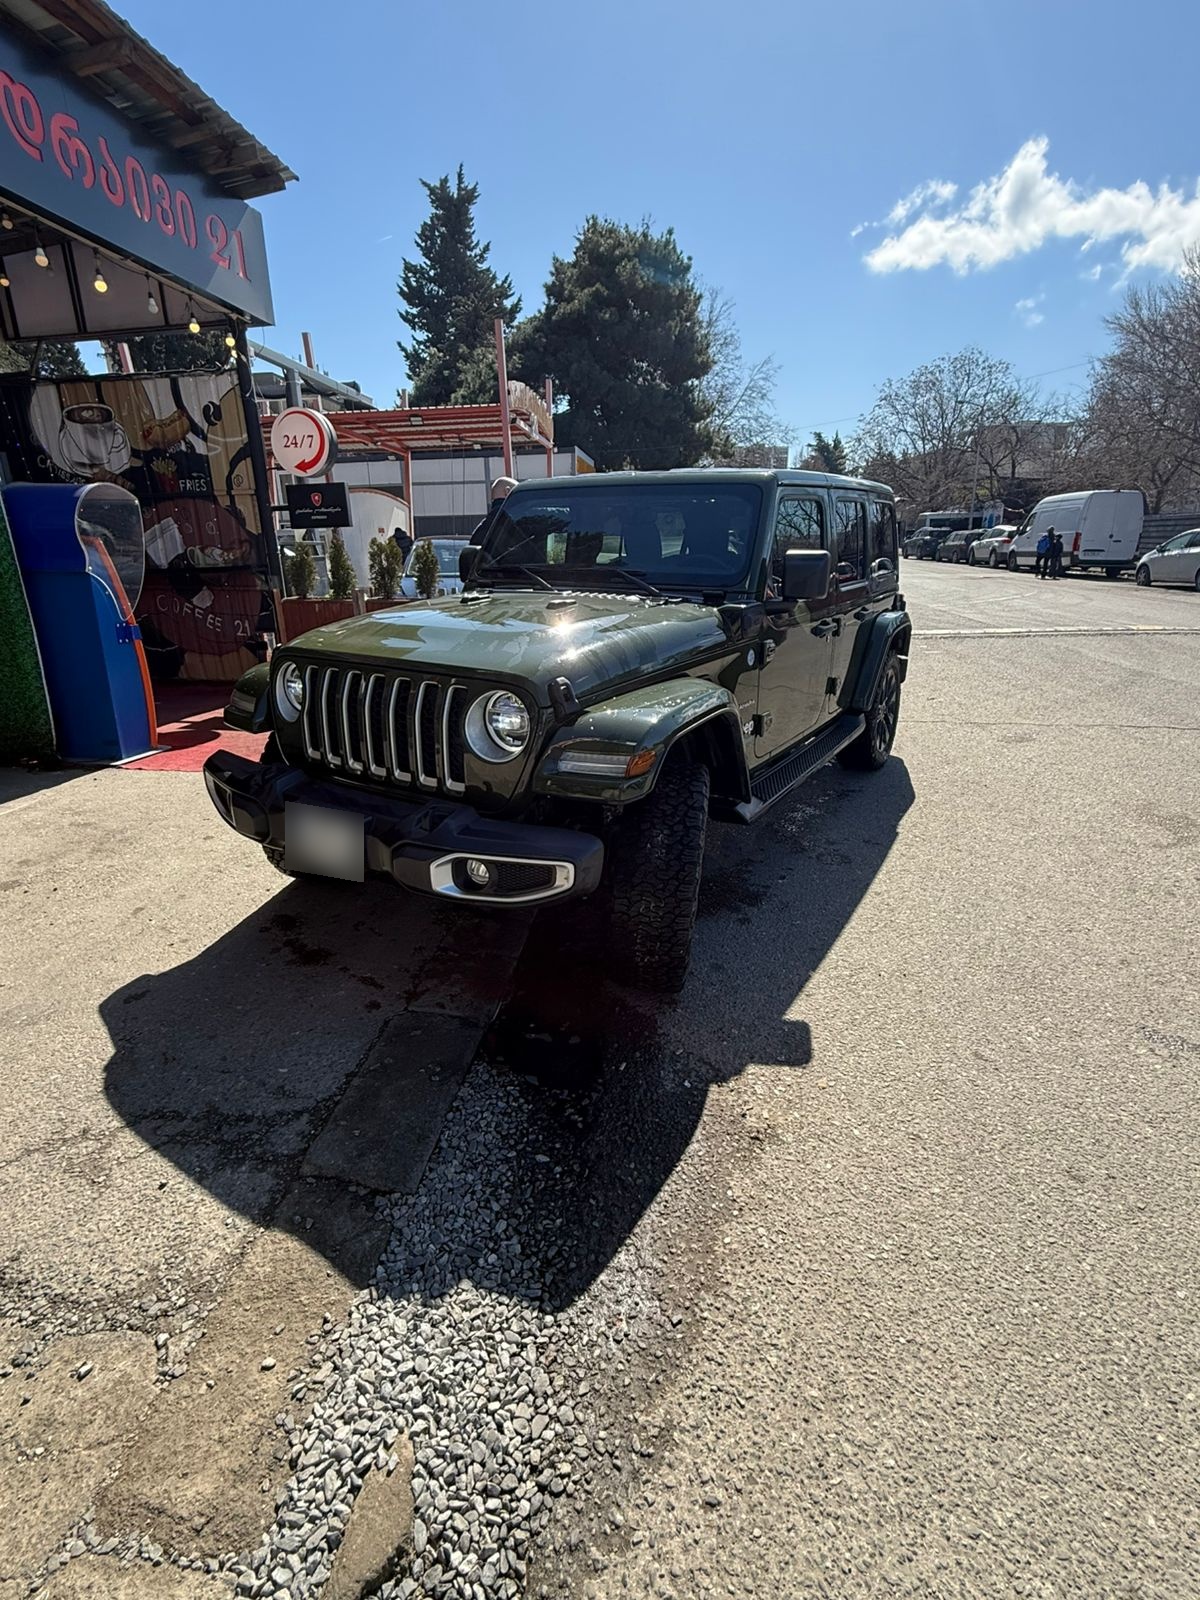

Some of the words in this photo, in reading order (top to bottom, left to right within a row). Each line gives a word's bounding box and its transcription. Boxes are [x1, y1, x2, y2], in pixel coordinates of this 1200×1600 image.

[0, 70, 198, 250] დრაივი
[206, 214, 251, 283] 21
[283, 434, 314, 449] 24/7
[178, 478, 207, 492] FRIES
[156, 594, 223, 632] COFFEE
[234, 619, 251, 637] 21
